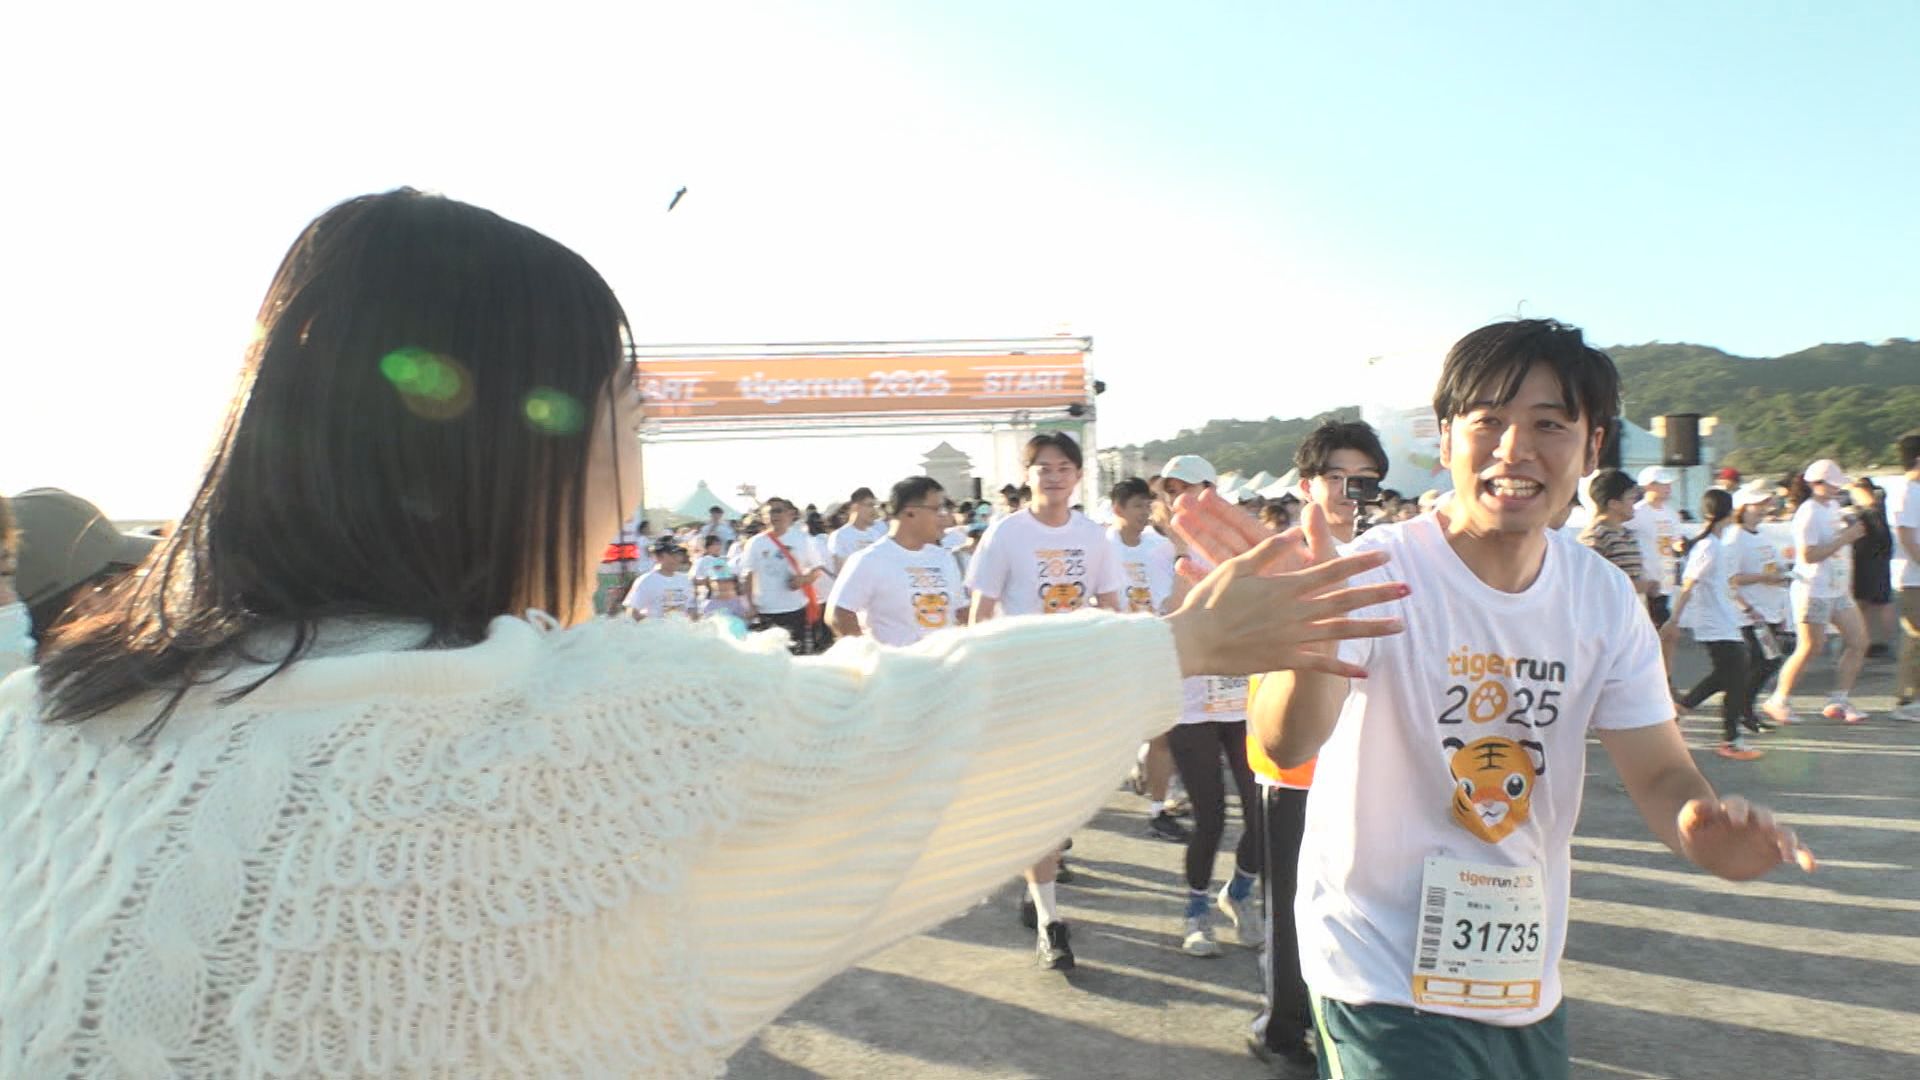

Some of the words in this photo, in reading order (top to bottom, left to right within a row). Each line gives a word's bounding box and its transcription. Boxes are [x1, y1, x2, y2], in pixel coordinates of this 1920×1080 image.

[640, 379, 704, 400] ART
[737, 370, 864, 404] tigerrun
[869, 369, 951, 397] 2025
[982, 371, 1069, 392] START
[1446, 645, 1566, 682] tigerrun
[1458, 870, 1512, 888] tigerrun
[1452, 919, 1540, 953] 31735
